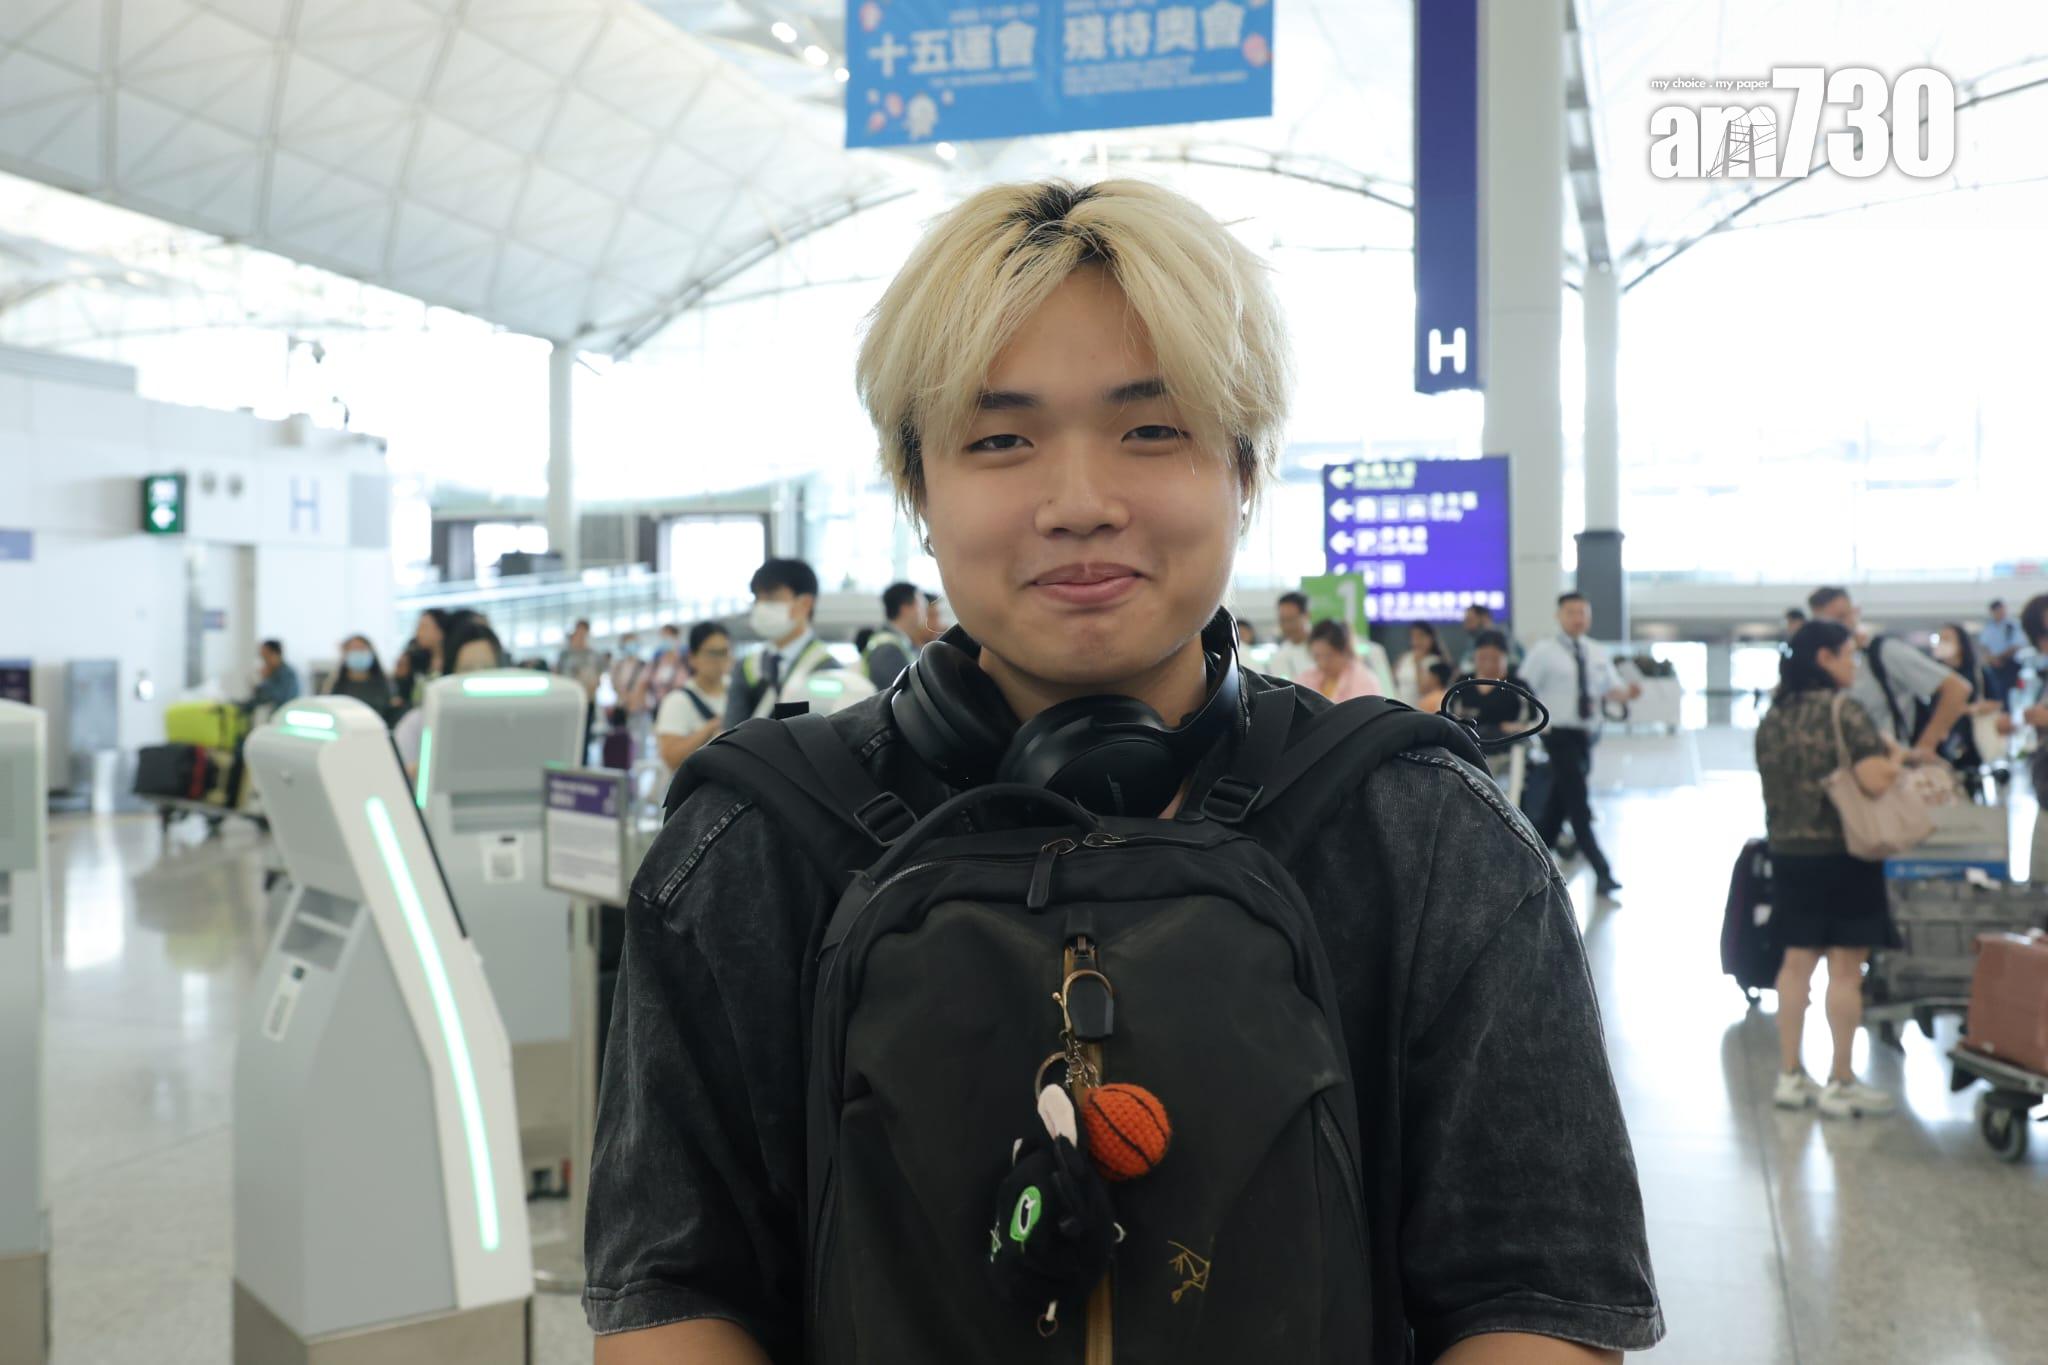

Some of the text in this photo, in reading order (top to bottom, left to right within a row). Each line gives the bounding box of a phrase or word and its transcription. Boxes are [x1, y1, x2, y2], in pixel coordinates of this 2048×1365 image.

[867, 20, 1037, 79] 十五運會
[1428, 327, 1466, 375] H
[289, 475, 321, 534] H
